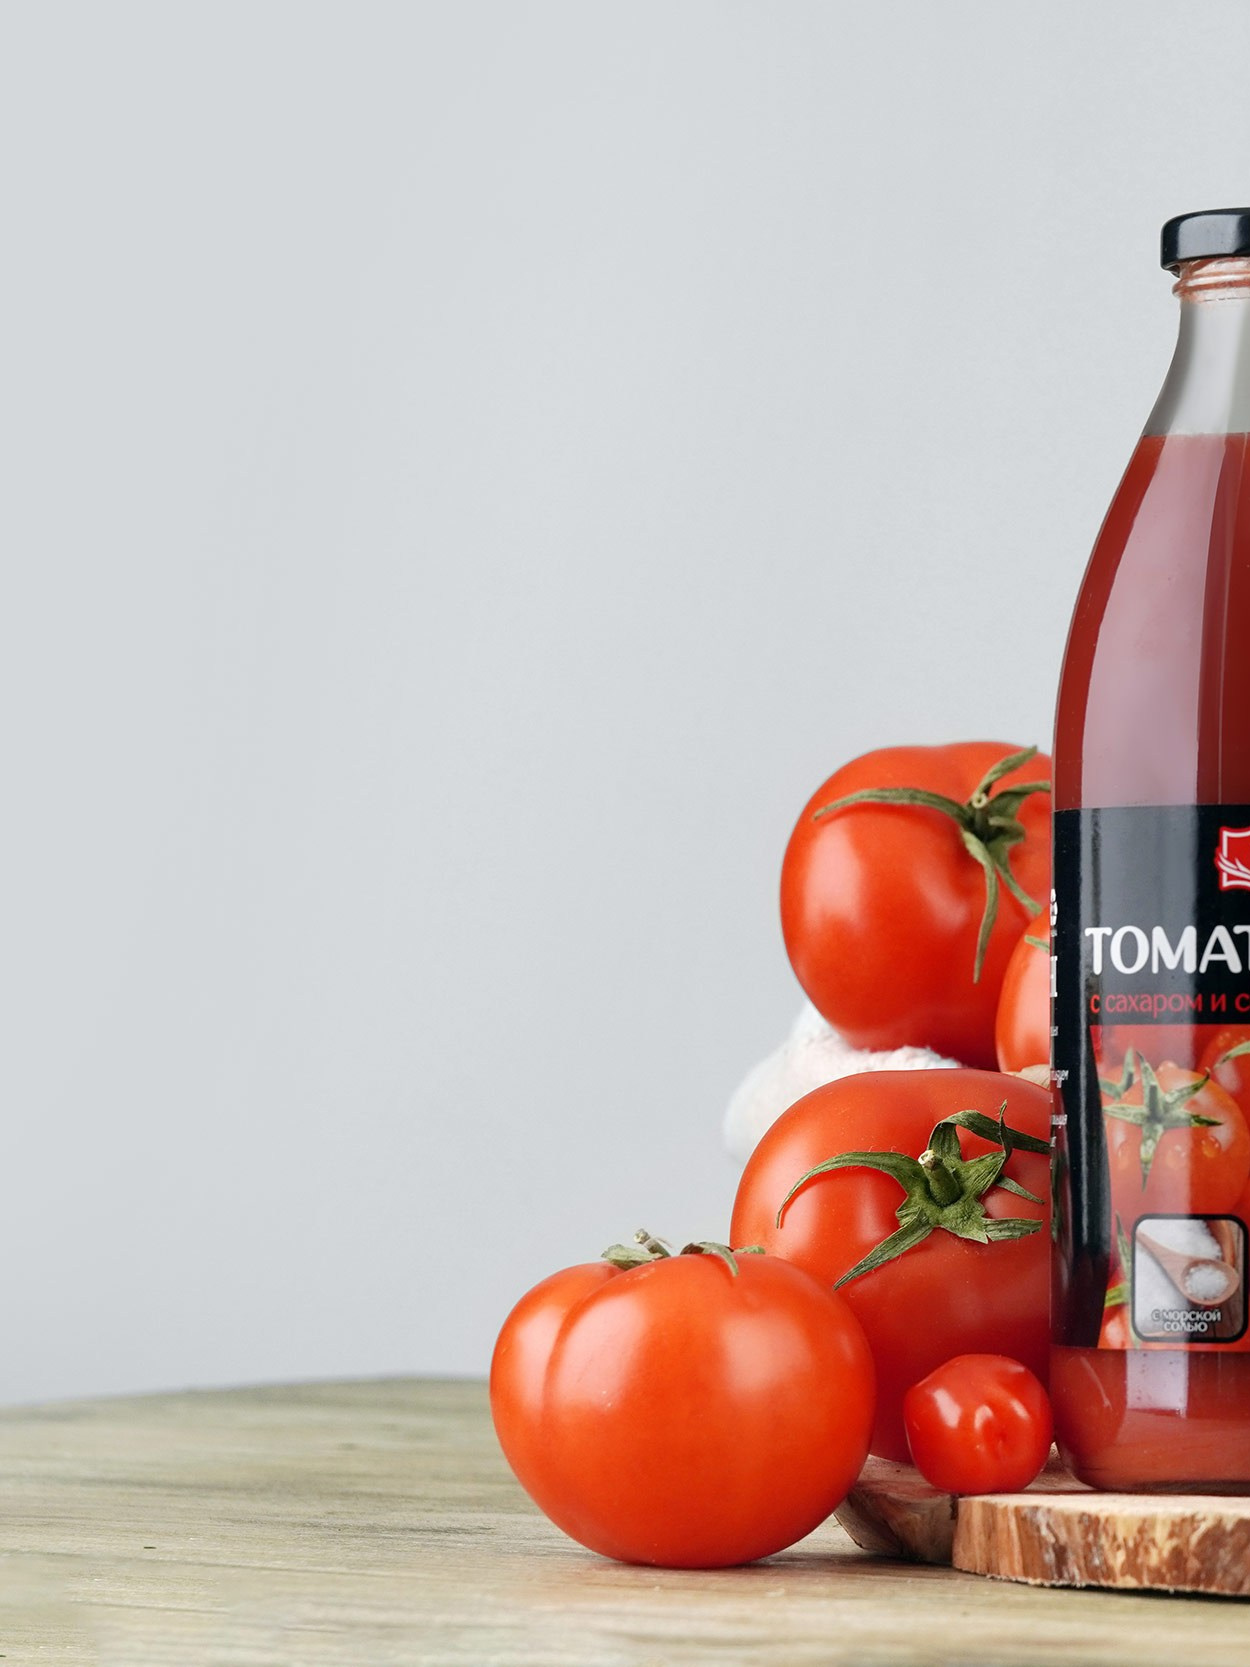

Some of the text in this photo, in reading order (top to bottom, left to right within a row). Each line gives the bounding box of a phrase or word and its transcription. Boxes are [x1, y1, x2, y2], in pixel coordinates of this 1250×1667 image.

[1090, 994, 1100, 1013] с
[1104, 993, 1203, 1019] сахаром
[1210, 993, 1227, 1012] и
[1163, 1321, 1208, 1333] солью
